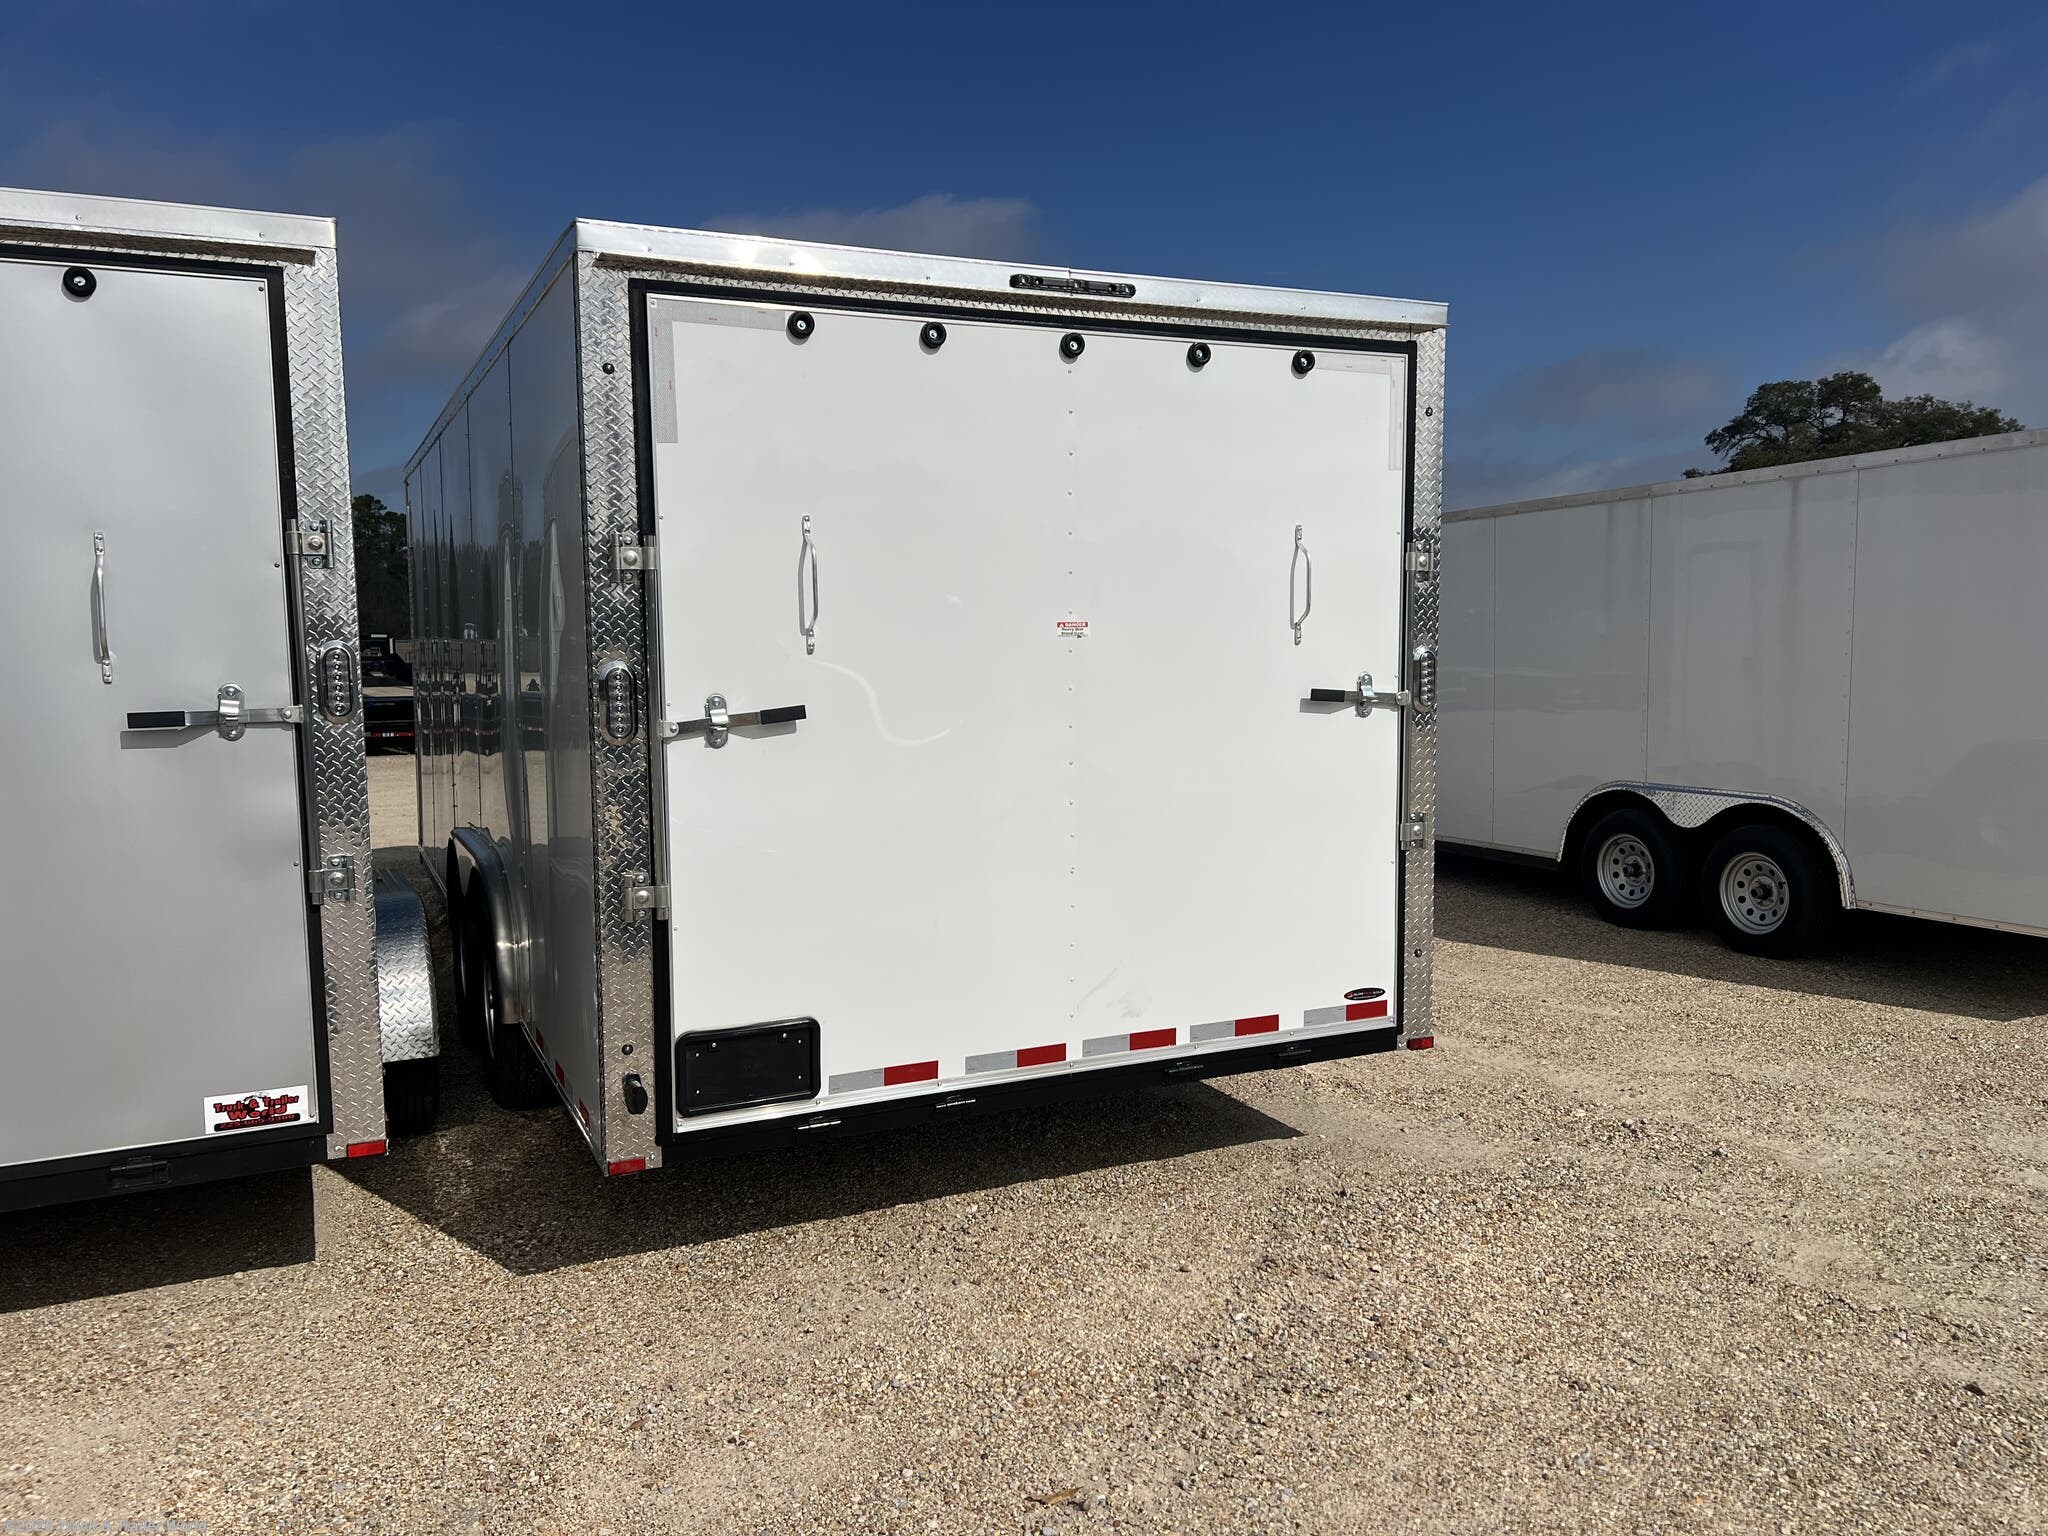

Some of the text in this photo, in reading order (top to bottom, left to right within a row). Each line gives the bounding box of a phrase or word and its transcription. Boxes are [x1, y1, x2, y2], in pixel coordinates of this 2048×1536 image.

[213, 1094, 299, 1113] Truck & Trailer
[227, 1104, 287, 1120] World
